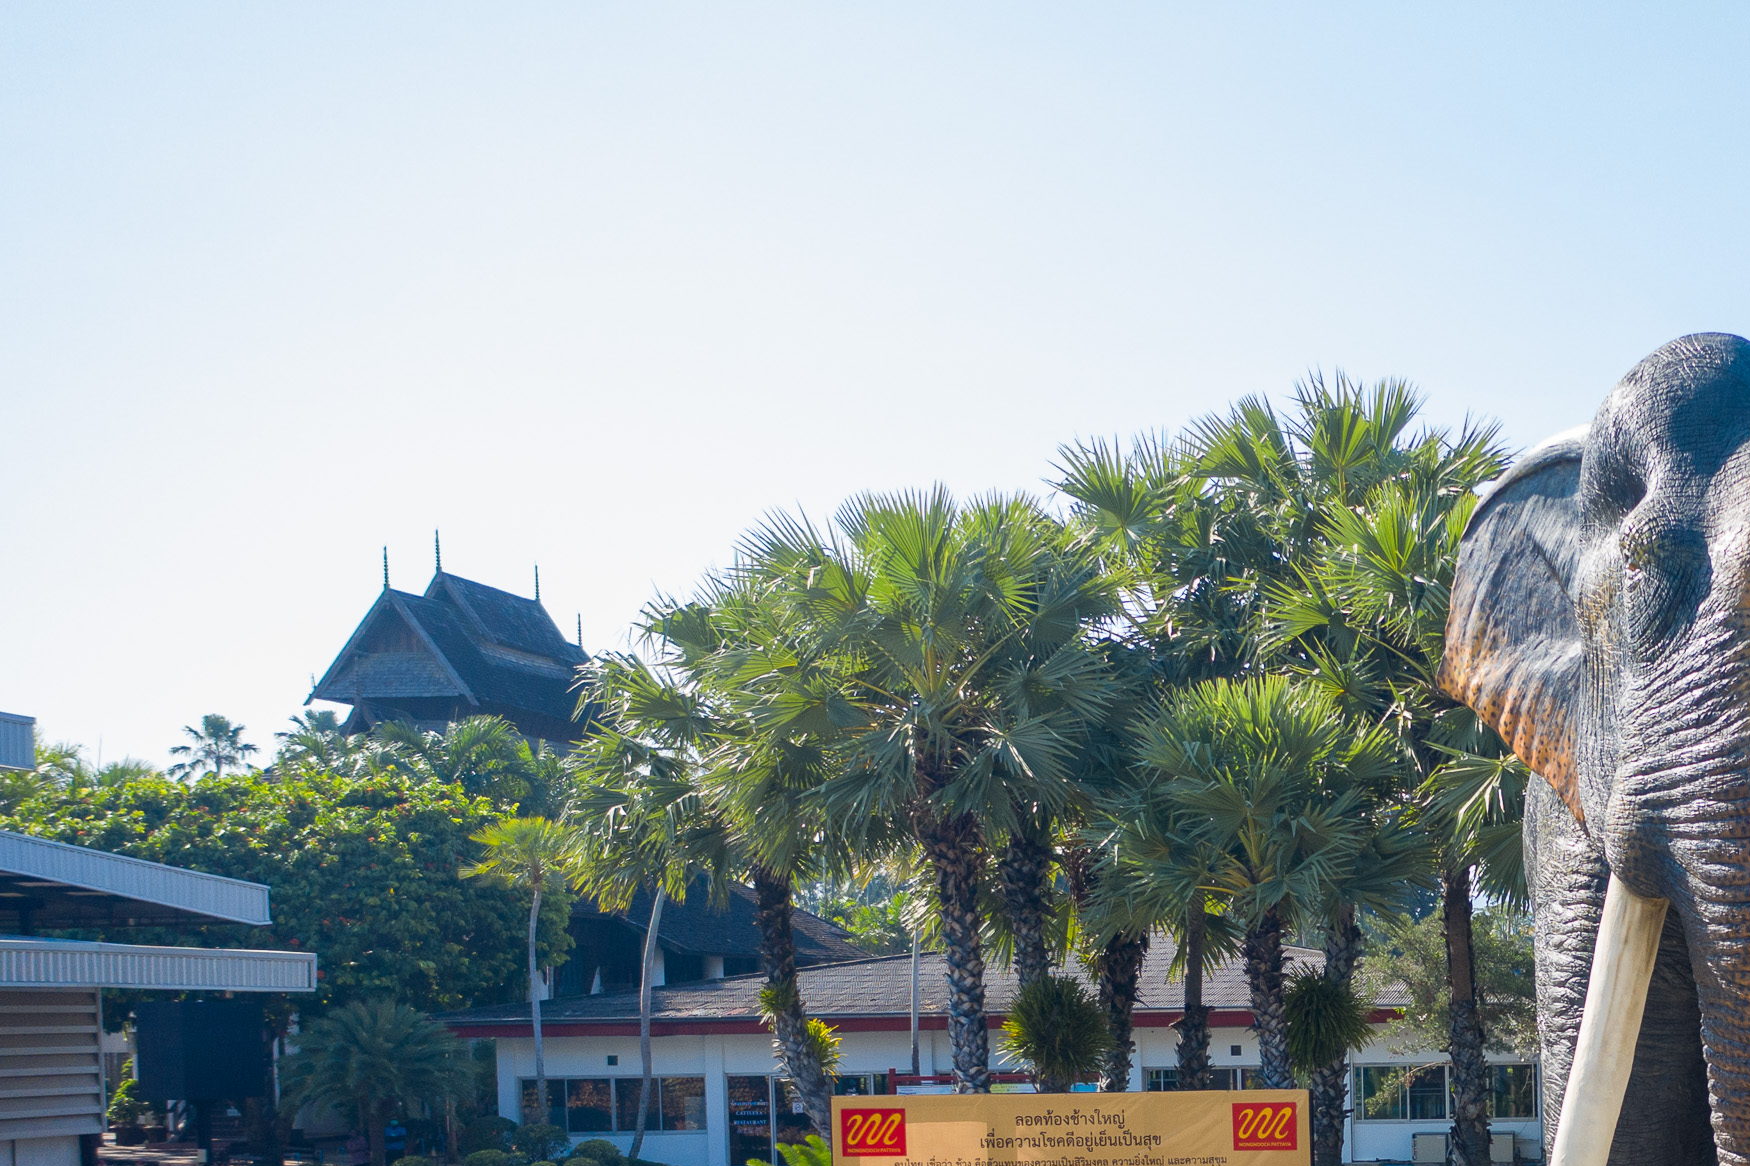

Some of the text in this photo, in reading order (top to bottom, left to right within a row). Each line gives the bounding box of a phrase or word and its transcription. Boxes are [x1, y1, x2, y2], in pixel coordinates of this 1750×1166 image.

[1015, 1108, 1126, 1129] ลอดท้องช้างใหญ่
[980, 1129, 1162, 1152] เพื่อความโชคดีอยู่เย็นเป็นสุข
